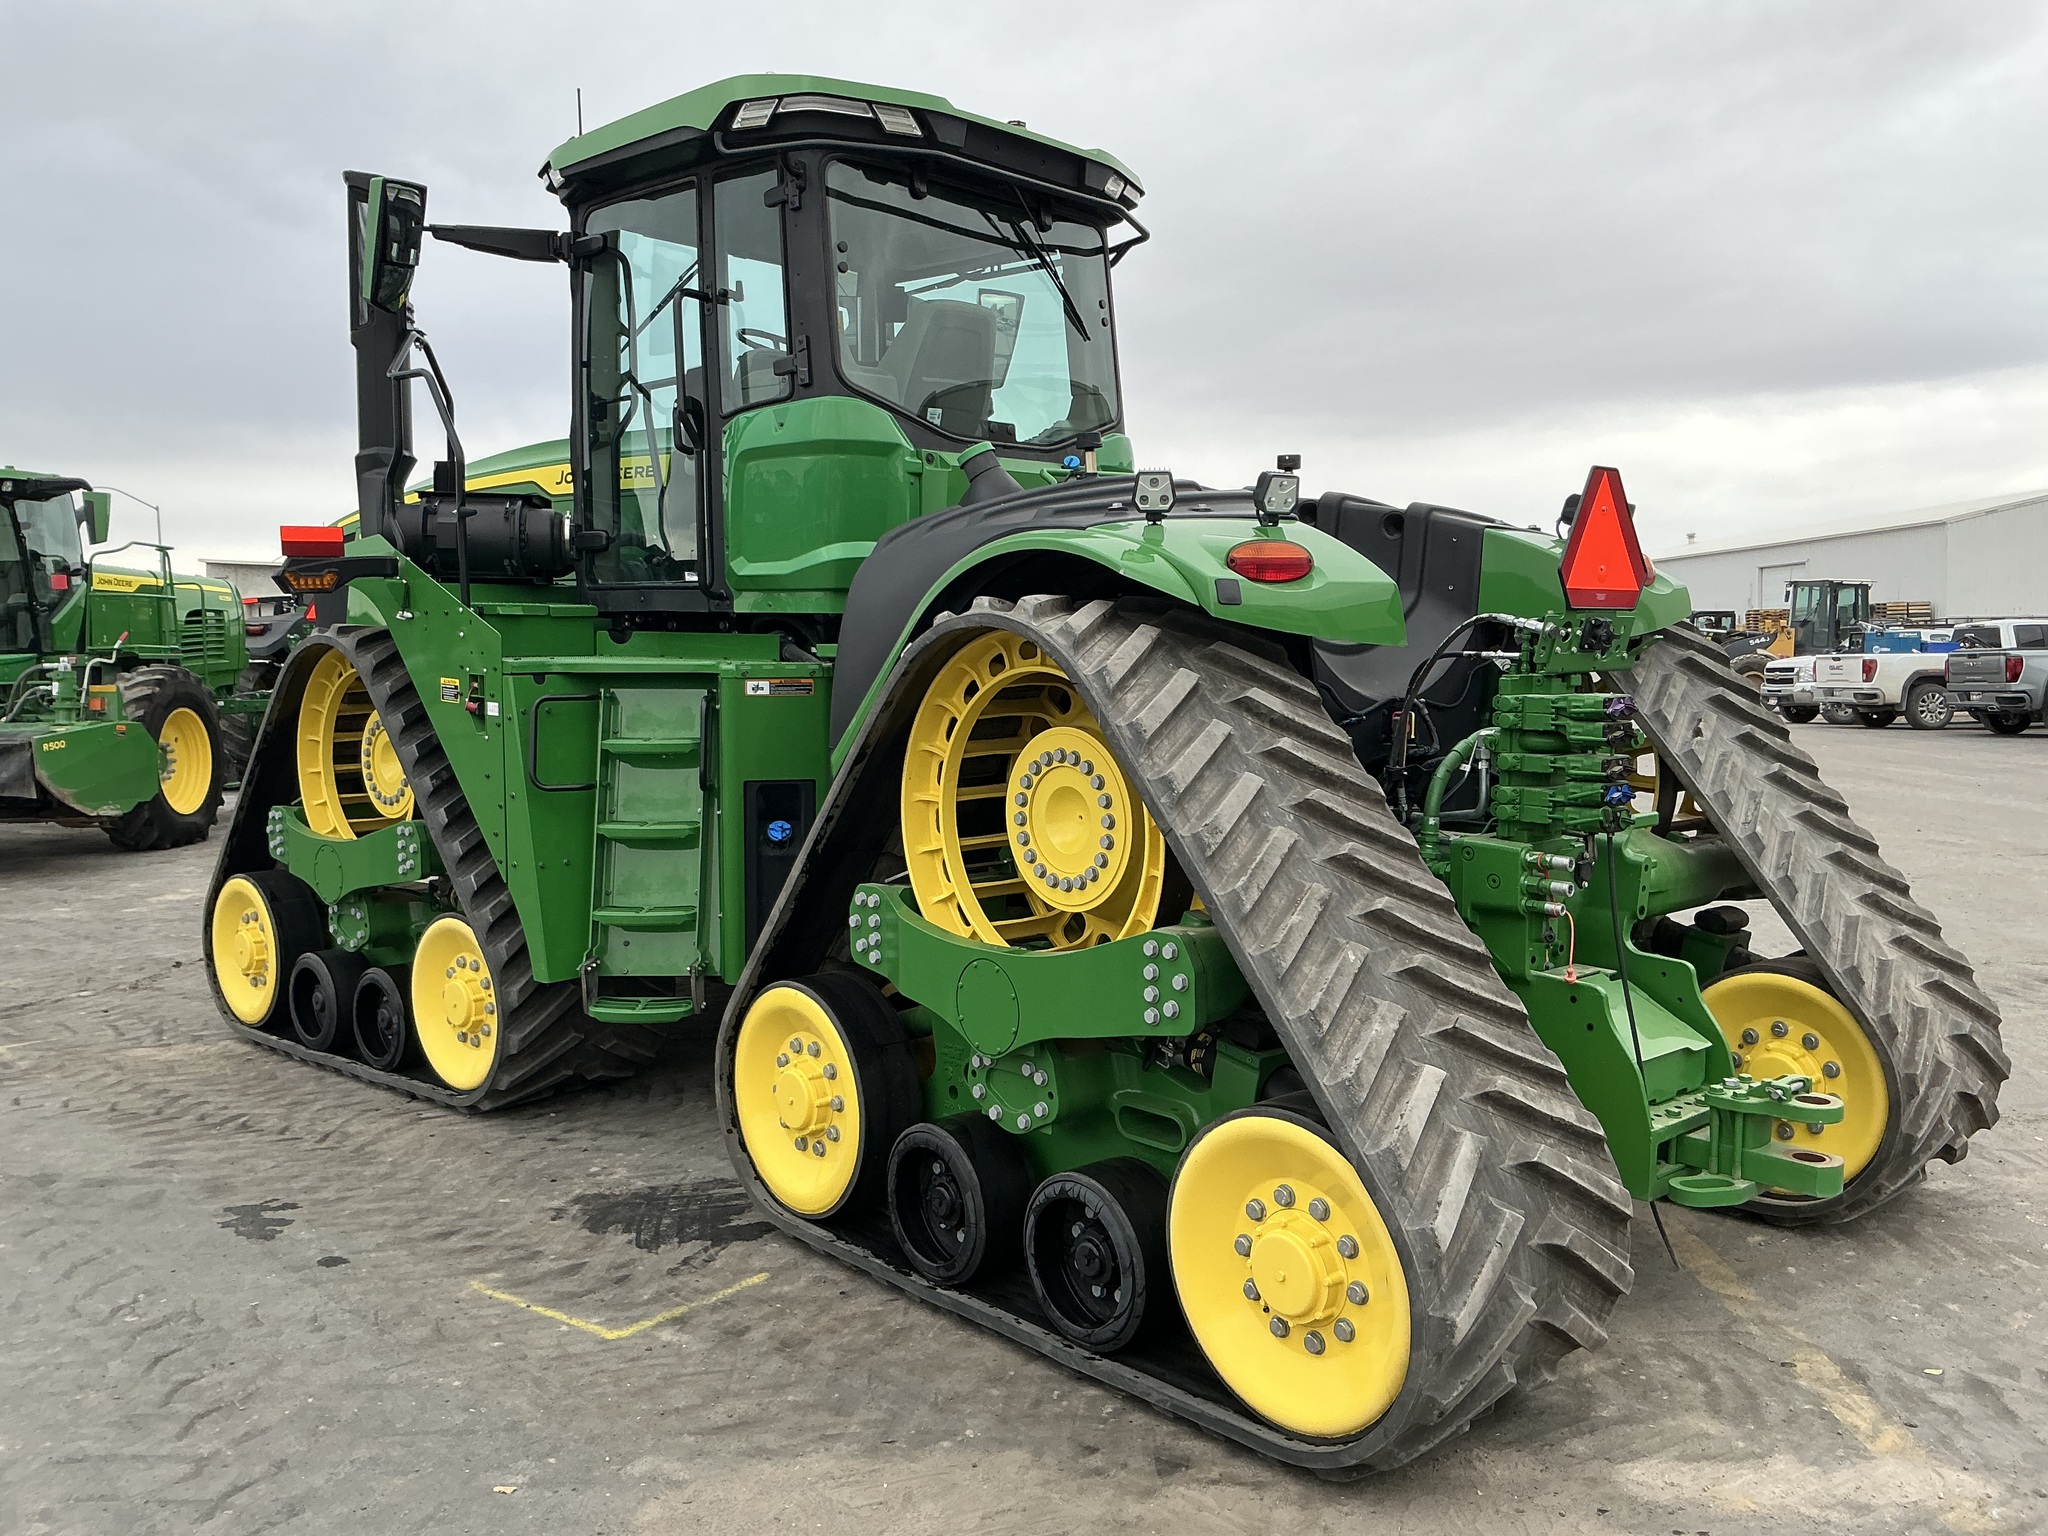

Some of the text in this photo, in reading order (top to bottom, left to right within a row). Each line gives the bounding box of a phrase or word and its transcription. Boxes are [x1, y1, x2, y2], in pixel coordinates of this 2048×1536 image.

[555, 470, 574, 485] JO
[96, 577, 133, 587] JOHN DEERE
[42, 740, 66, 752] R500
